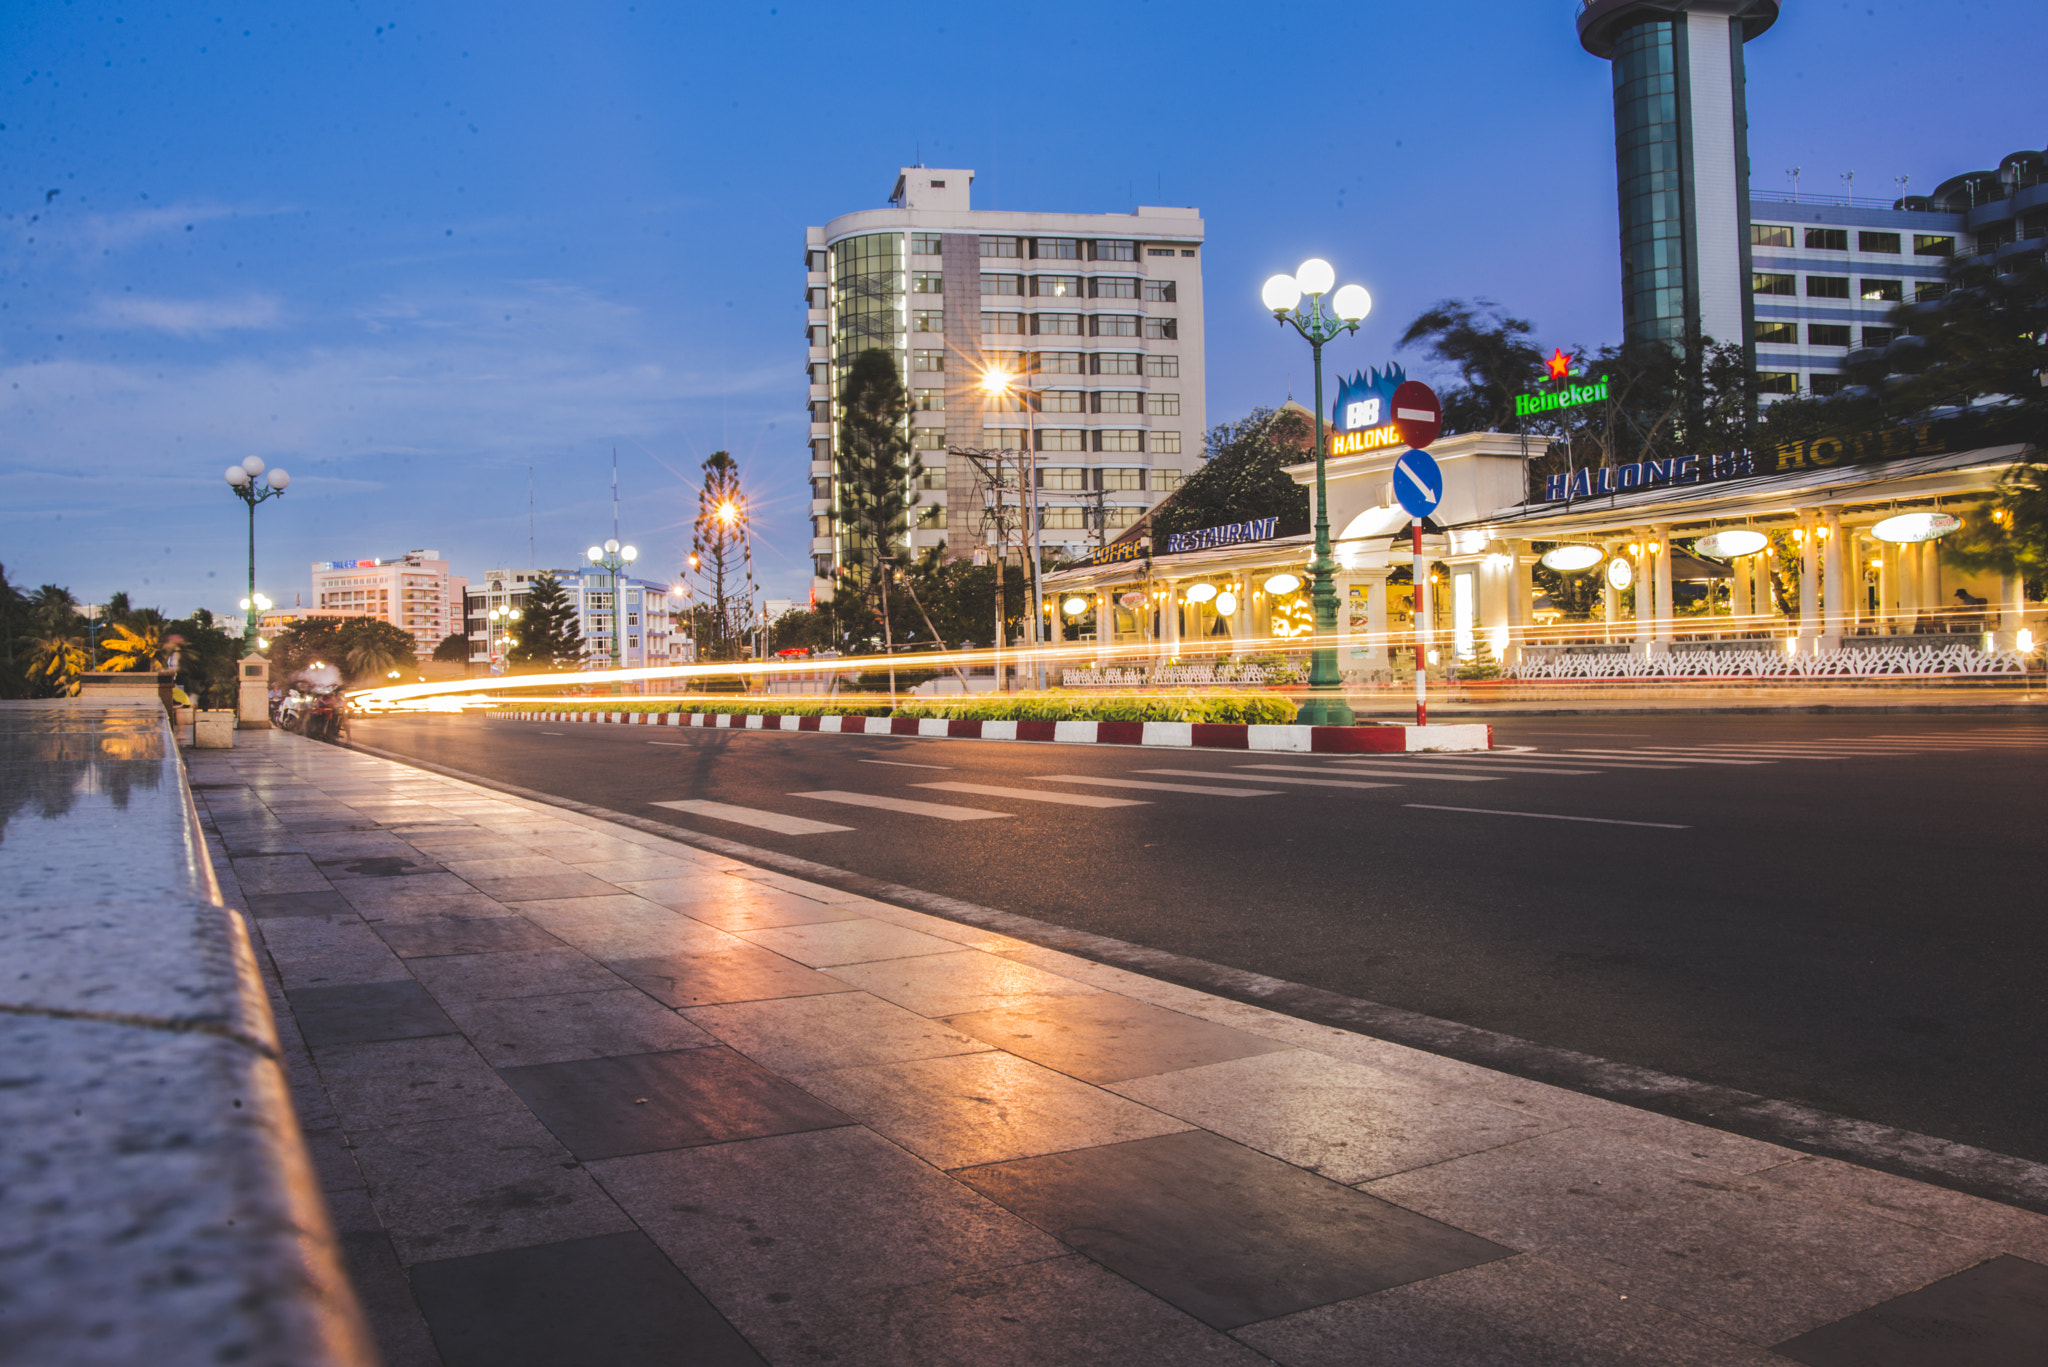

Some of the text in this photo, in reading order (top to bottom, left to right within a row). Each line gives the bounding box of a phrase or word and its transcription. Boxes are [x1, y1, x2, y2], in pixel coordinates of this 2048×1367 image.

[1515, 382, 1608, 416] Heineken
[1333, 425, 1400, 455] HALONG
[1168, 516, 1279, 552] RESTAURANT
[1092, 539, 1142, 565] COFFEE
